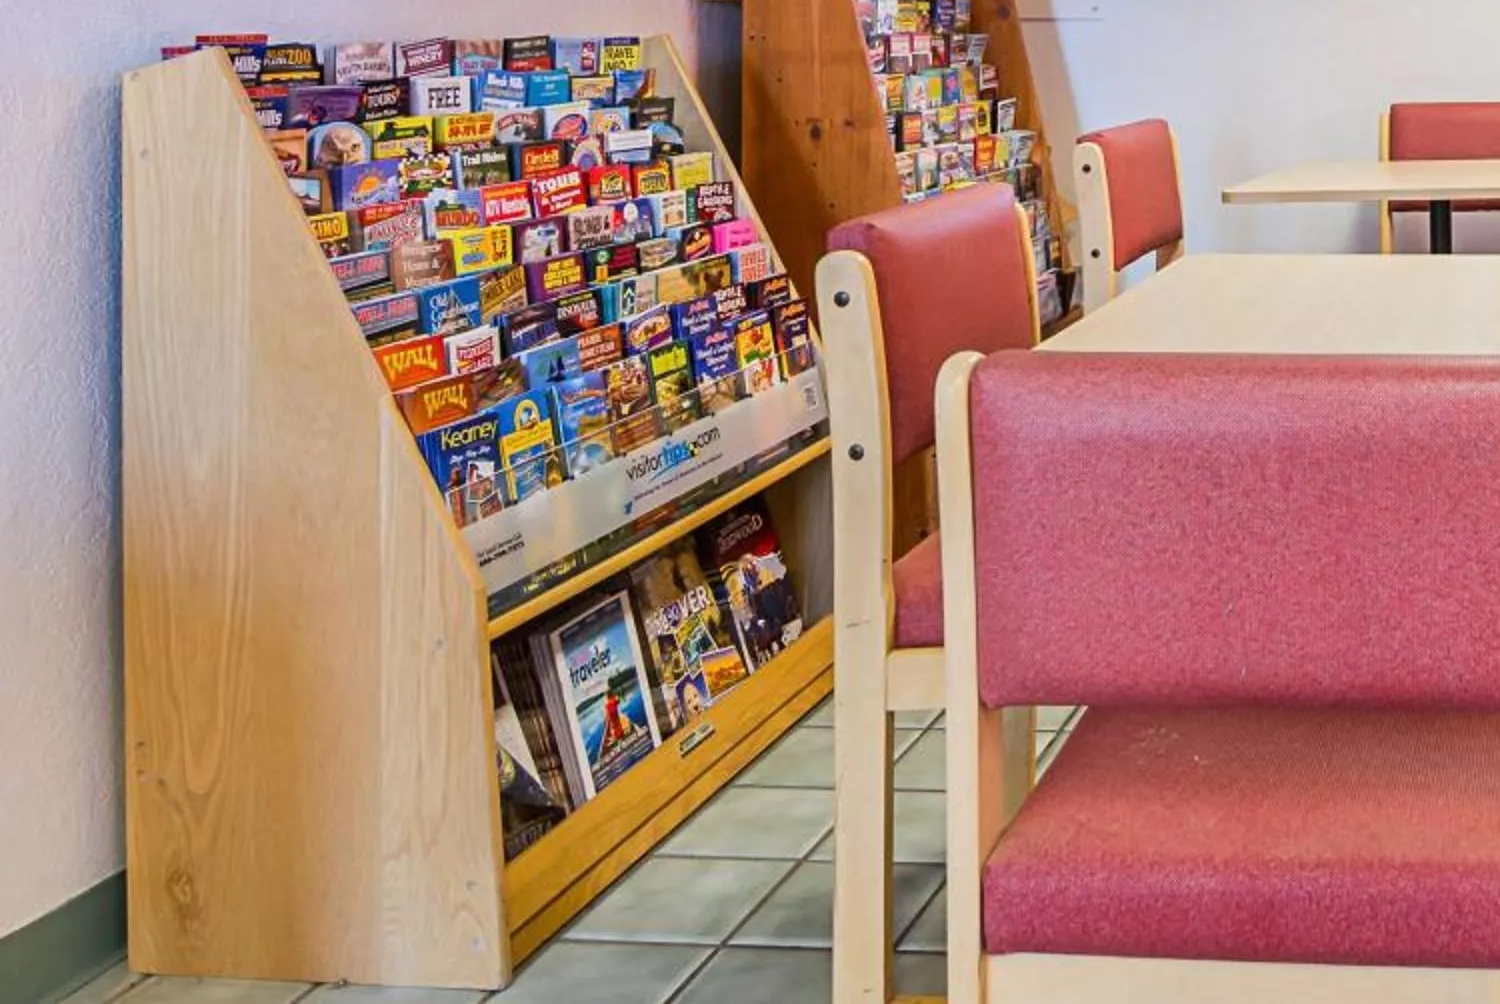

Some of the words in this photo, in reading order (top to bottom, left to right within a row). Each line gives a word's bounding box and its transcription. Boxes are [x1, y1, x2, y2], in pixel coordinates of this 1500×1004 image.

[428, 87, 461, 108] FREE
[382, 343, 438, 383] WALL
[423, 382, 468, 420] WALL
[440, 419, 499, 451] Kearney
